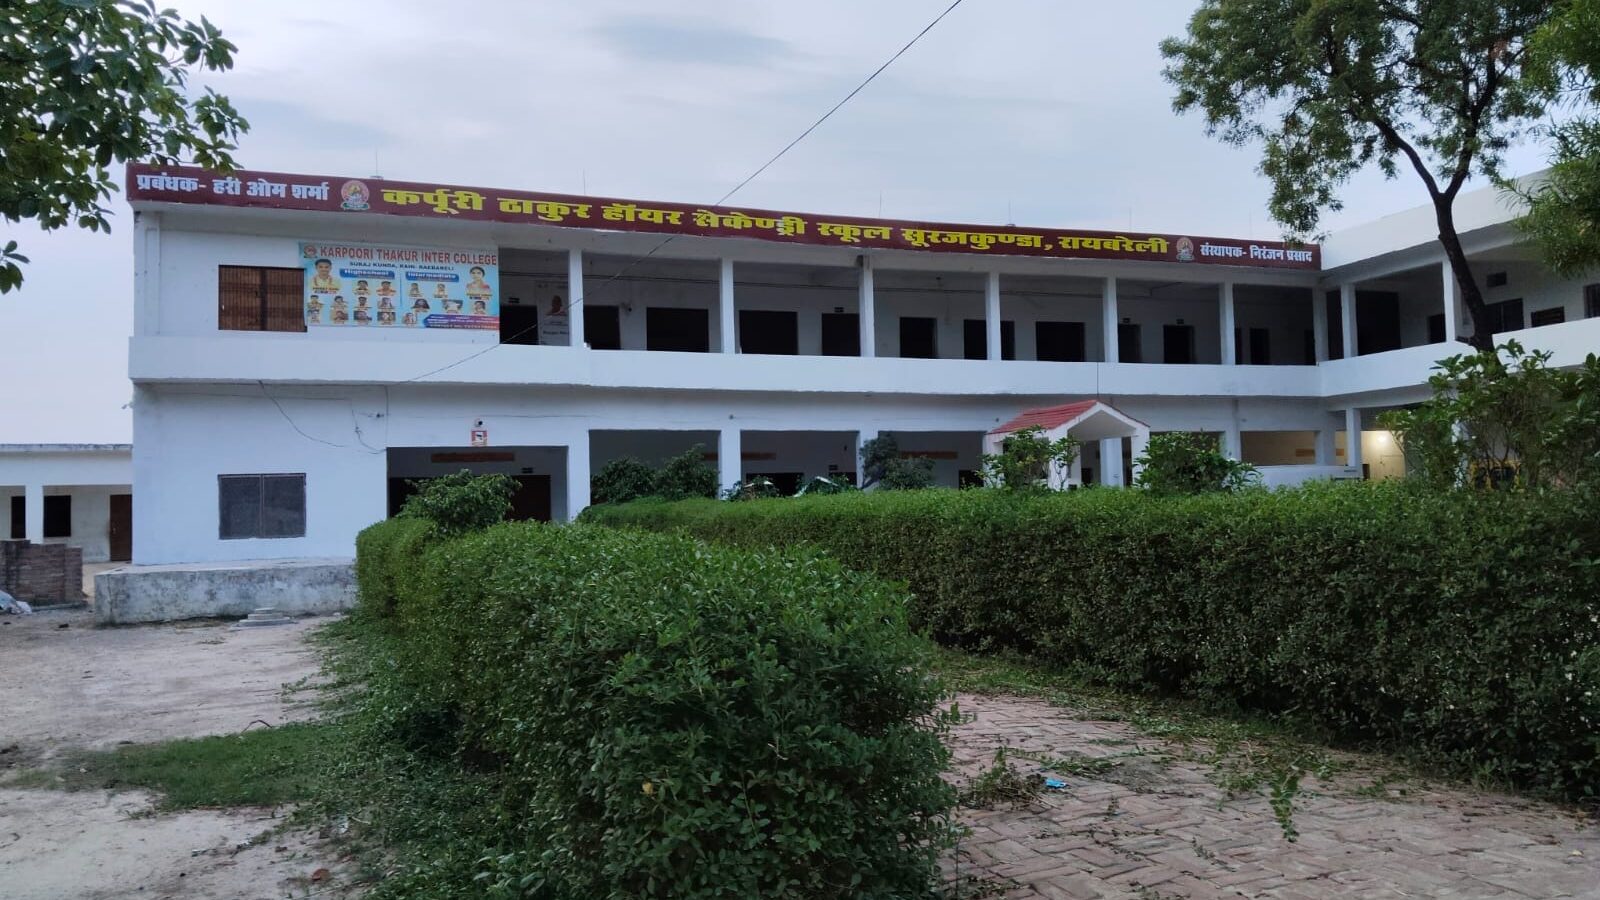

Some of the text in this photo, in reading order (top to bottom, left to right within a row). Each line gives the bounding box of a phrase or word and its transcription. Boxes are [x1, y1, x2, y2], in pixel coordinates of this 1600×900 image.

[136, 172, 206, 192] प्रबंधक-
[247, 178, 286, 198] ओम
[291, 181, 329, 201] शर्मा
[380, 189, 486, 215] कर्पूरी
[497, 197, 593, 222] ठाकुर
[600, 203, 684, 225] हॉयर
[816, 222, 893, 243] स्कूल
[1058, 236, 1169, 253] रायबरेली
[320, 246, 497, 266] KARPOORI THAKUR INTER COLLEGE
[1249, 244, 1284, 261] निरंजन
[1286, 250, 1312, 263] प्रसाद
